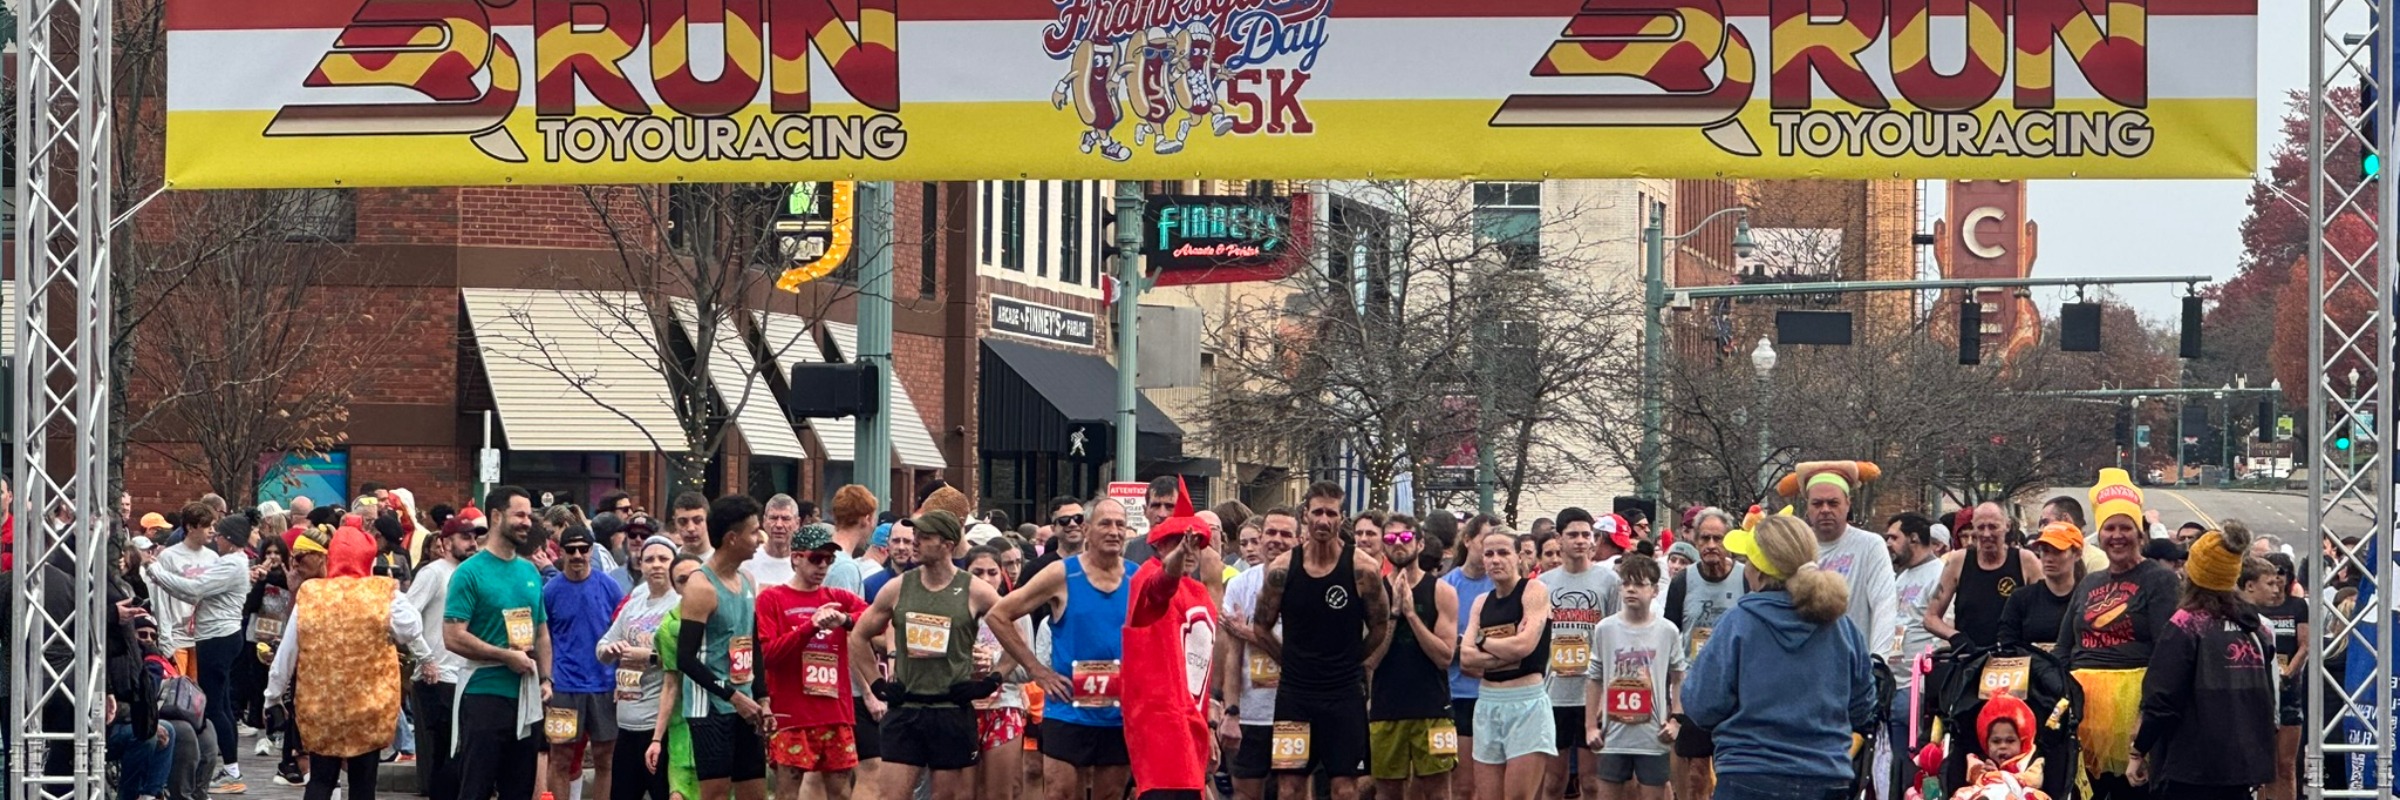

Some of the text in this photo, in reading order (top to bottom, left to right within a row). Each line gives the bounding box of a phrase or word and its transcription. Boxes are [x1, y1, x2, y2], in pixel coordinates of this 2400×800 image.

[1226, 10, 1330, 71] Day
[534, 0, 902, 116] RUN
[1769, 0, 2149, 112] RUN
[1226, 68, 1315, 135] 5K
[535, 115, 907, 162] TOYOURACING
[1771, 111, 2154, 158] TOYOURACING
[1024, 306, 1062, 338] FINNEY'S
[511, 623, 534, 641] 59
[732, 650, 753, 671] 30
[1252, 657, 1282, 675] 73
[1554, 647, 1588, 665] 415
[806, 665, 838, 685] 209
[1083, 675, 1110, 694] 47
[1985, 670, 2025, 688] 667
[1616, 691, 1642, 711] 16
[1433, 731, 1459, 749] 59
